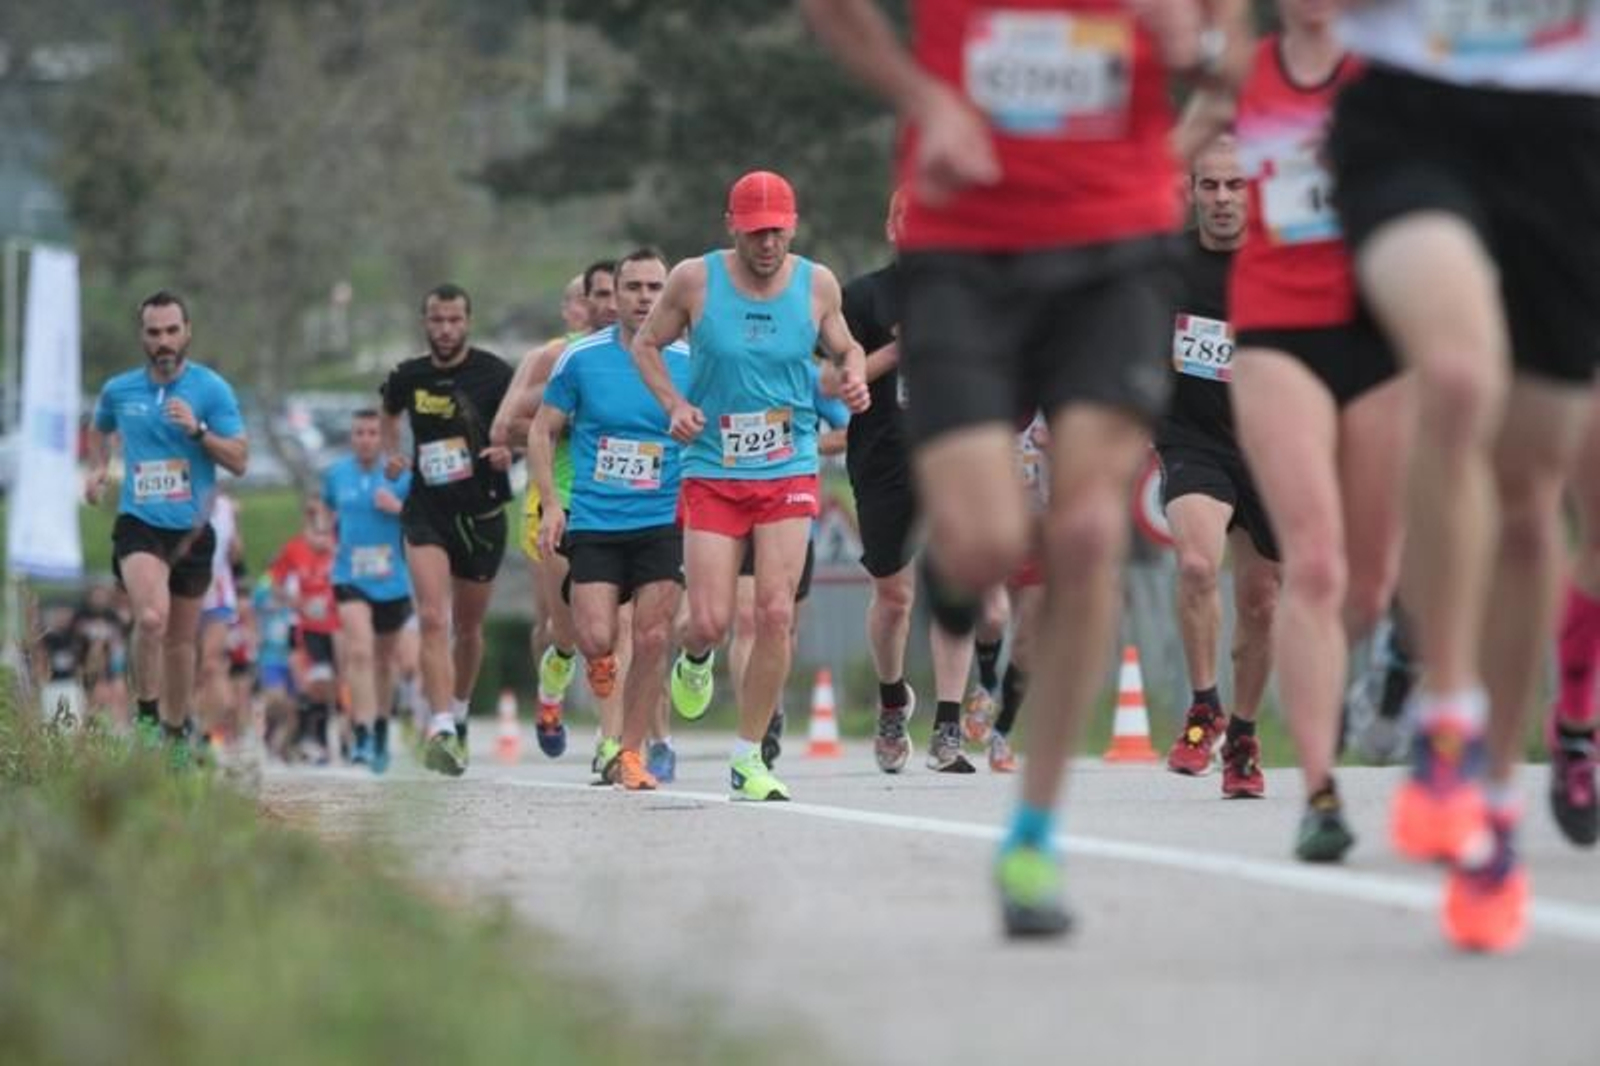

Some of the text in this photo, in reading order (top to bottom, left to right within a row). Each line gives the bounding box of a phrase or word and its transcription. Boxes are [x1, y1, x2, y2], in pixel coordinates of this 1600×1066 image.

[1181, 336, 1234, 365] 789
[727, 429, 777, 453] 722
[601, 455, 645, 476] 375
